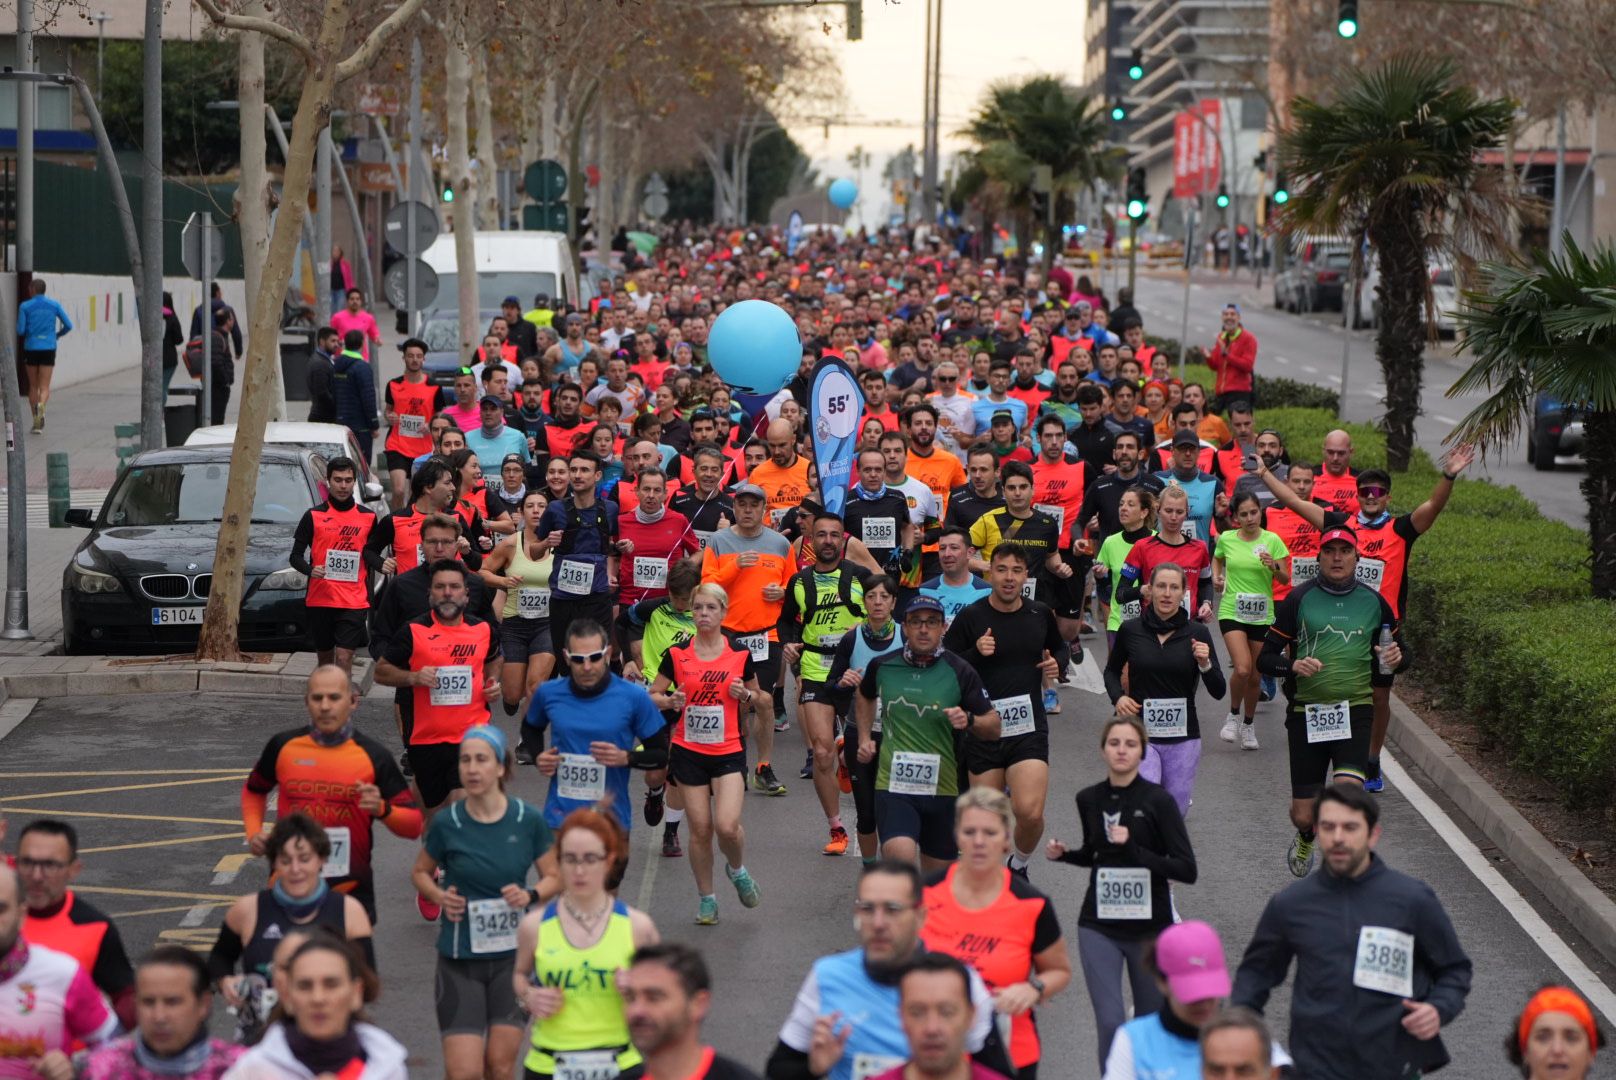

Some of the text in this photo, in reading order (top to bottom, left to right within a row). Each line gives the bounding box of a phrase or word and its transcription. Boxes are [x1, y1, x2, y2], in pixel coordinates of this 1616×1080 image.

[1047, 480, 1067, 490] RUN
[339, 525, 361, 537] RUN
[865, 525, 892, 537] 3385
[328, 557, 354, 570] 3831
[561, 568, 589, 583] 3181
[636, 564, 663, 577] 3507
[1355, 565, 1379, 580] 339
[520, 595, 548, 607] 3224
[821, 593, 837, 605] RU
[1122, 603, 1140, 615] 363
[1238, 600, 1265, 612] 3416
[160, 609, 196, 622] 6104
[815, 612, 839, 626] LIFE
[450, 644, 477, 657] RUN
[700, 670, 730, 683] RUN
[702, 683, 717, 691] FOR
[690, 690, 720, 704] LIFE
[687, 714, 720, 730] 3722
[1148, 708, 1182, 723] 3267
[1310, 711, 1345, 728] 3582
[561, 765, 599, 784] 3583
[895, 762, 933, 780] 3573
[1102, 881, 1144, 900] 3960
[475, 911, 520, 933] 3428
[955, 932, 1001, 954] RUN
